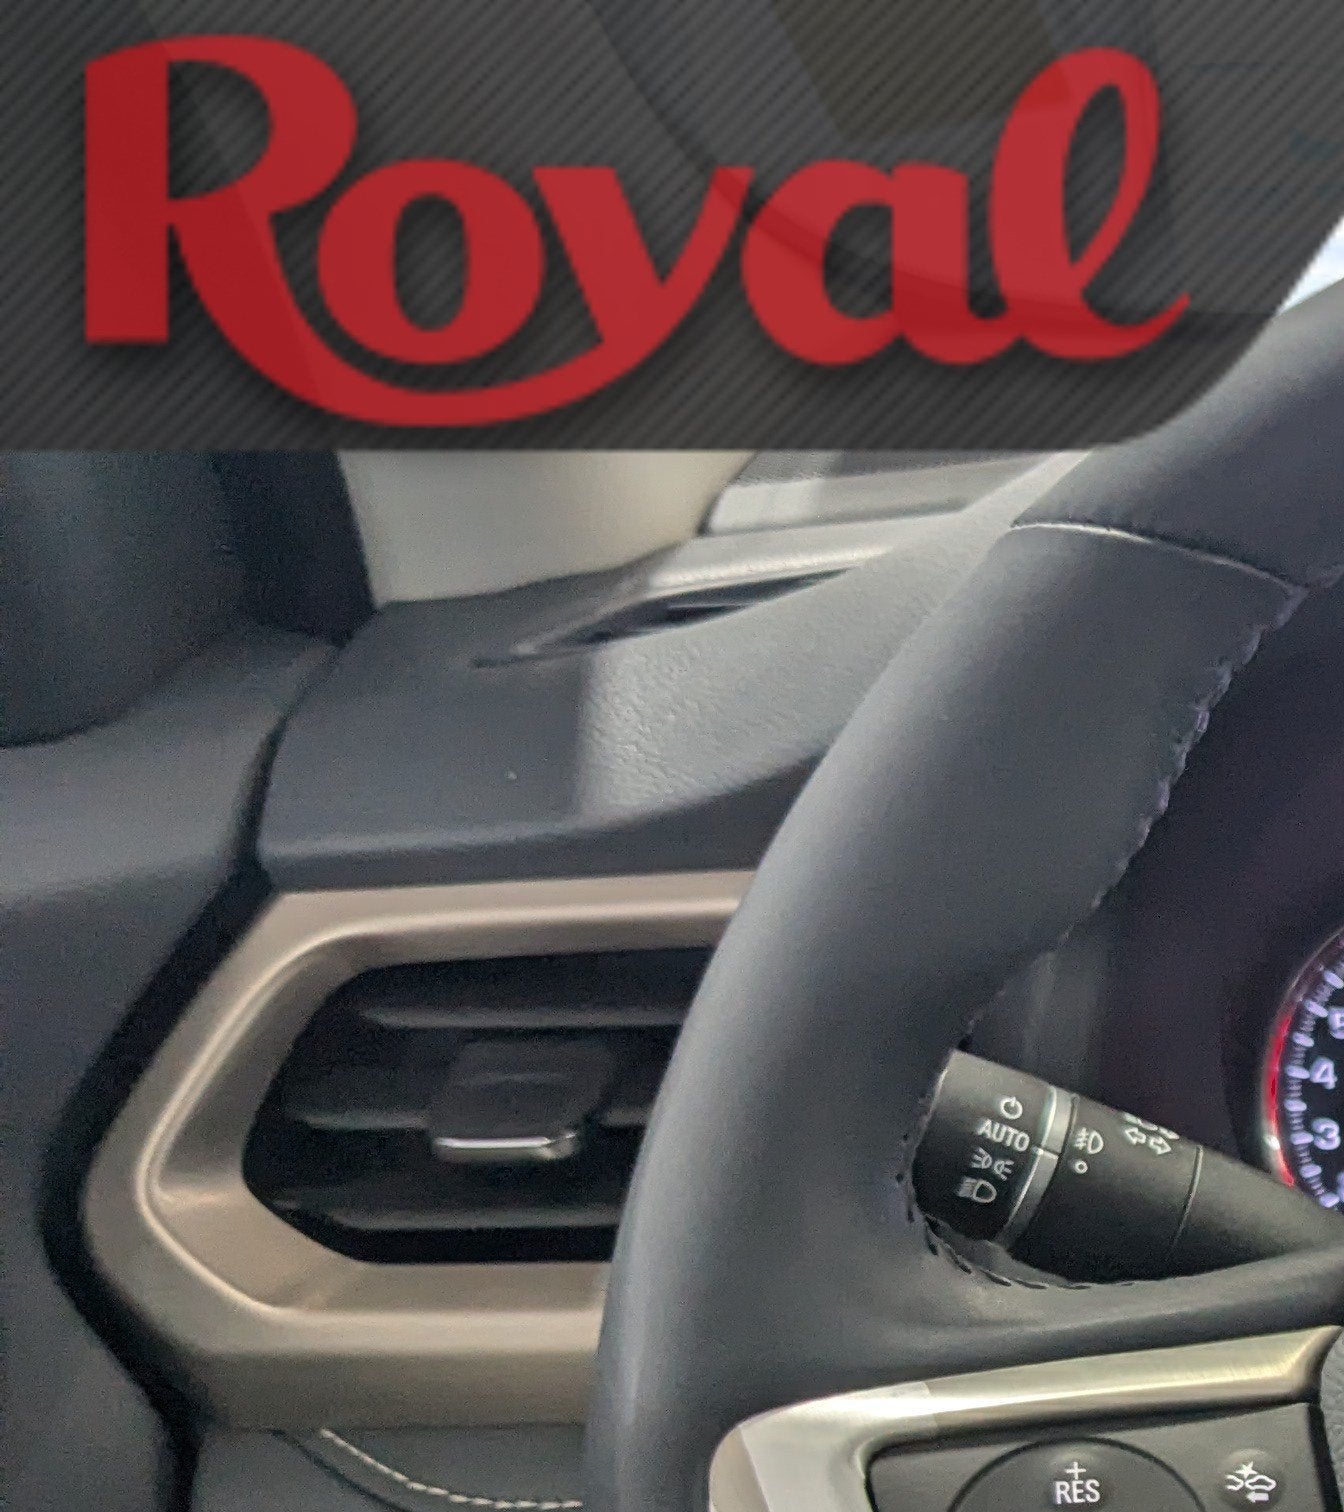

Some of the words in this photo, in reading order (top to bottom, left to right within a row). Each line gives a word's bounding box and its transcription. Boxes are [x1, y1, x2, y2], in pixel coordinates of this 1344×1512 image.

[1311, 1057, 1337, 1090] 4
[976, 1118, 1031, 1152] AUTO
[1312, 1118, 1341, 1153] 3
[1055, 1480, 1101, 1505] RES
